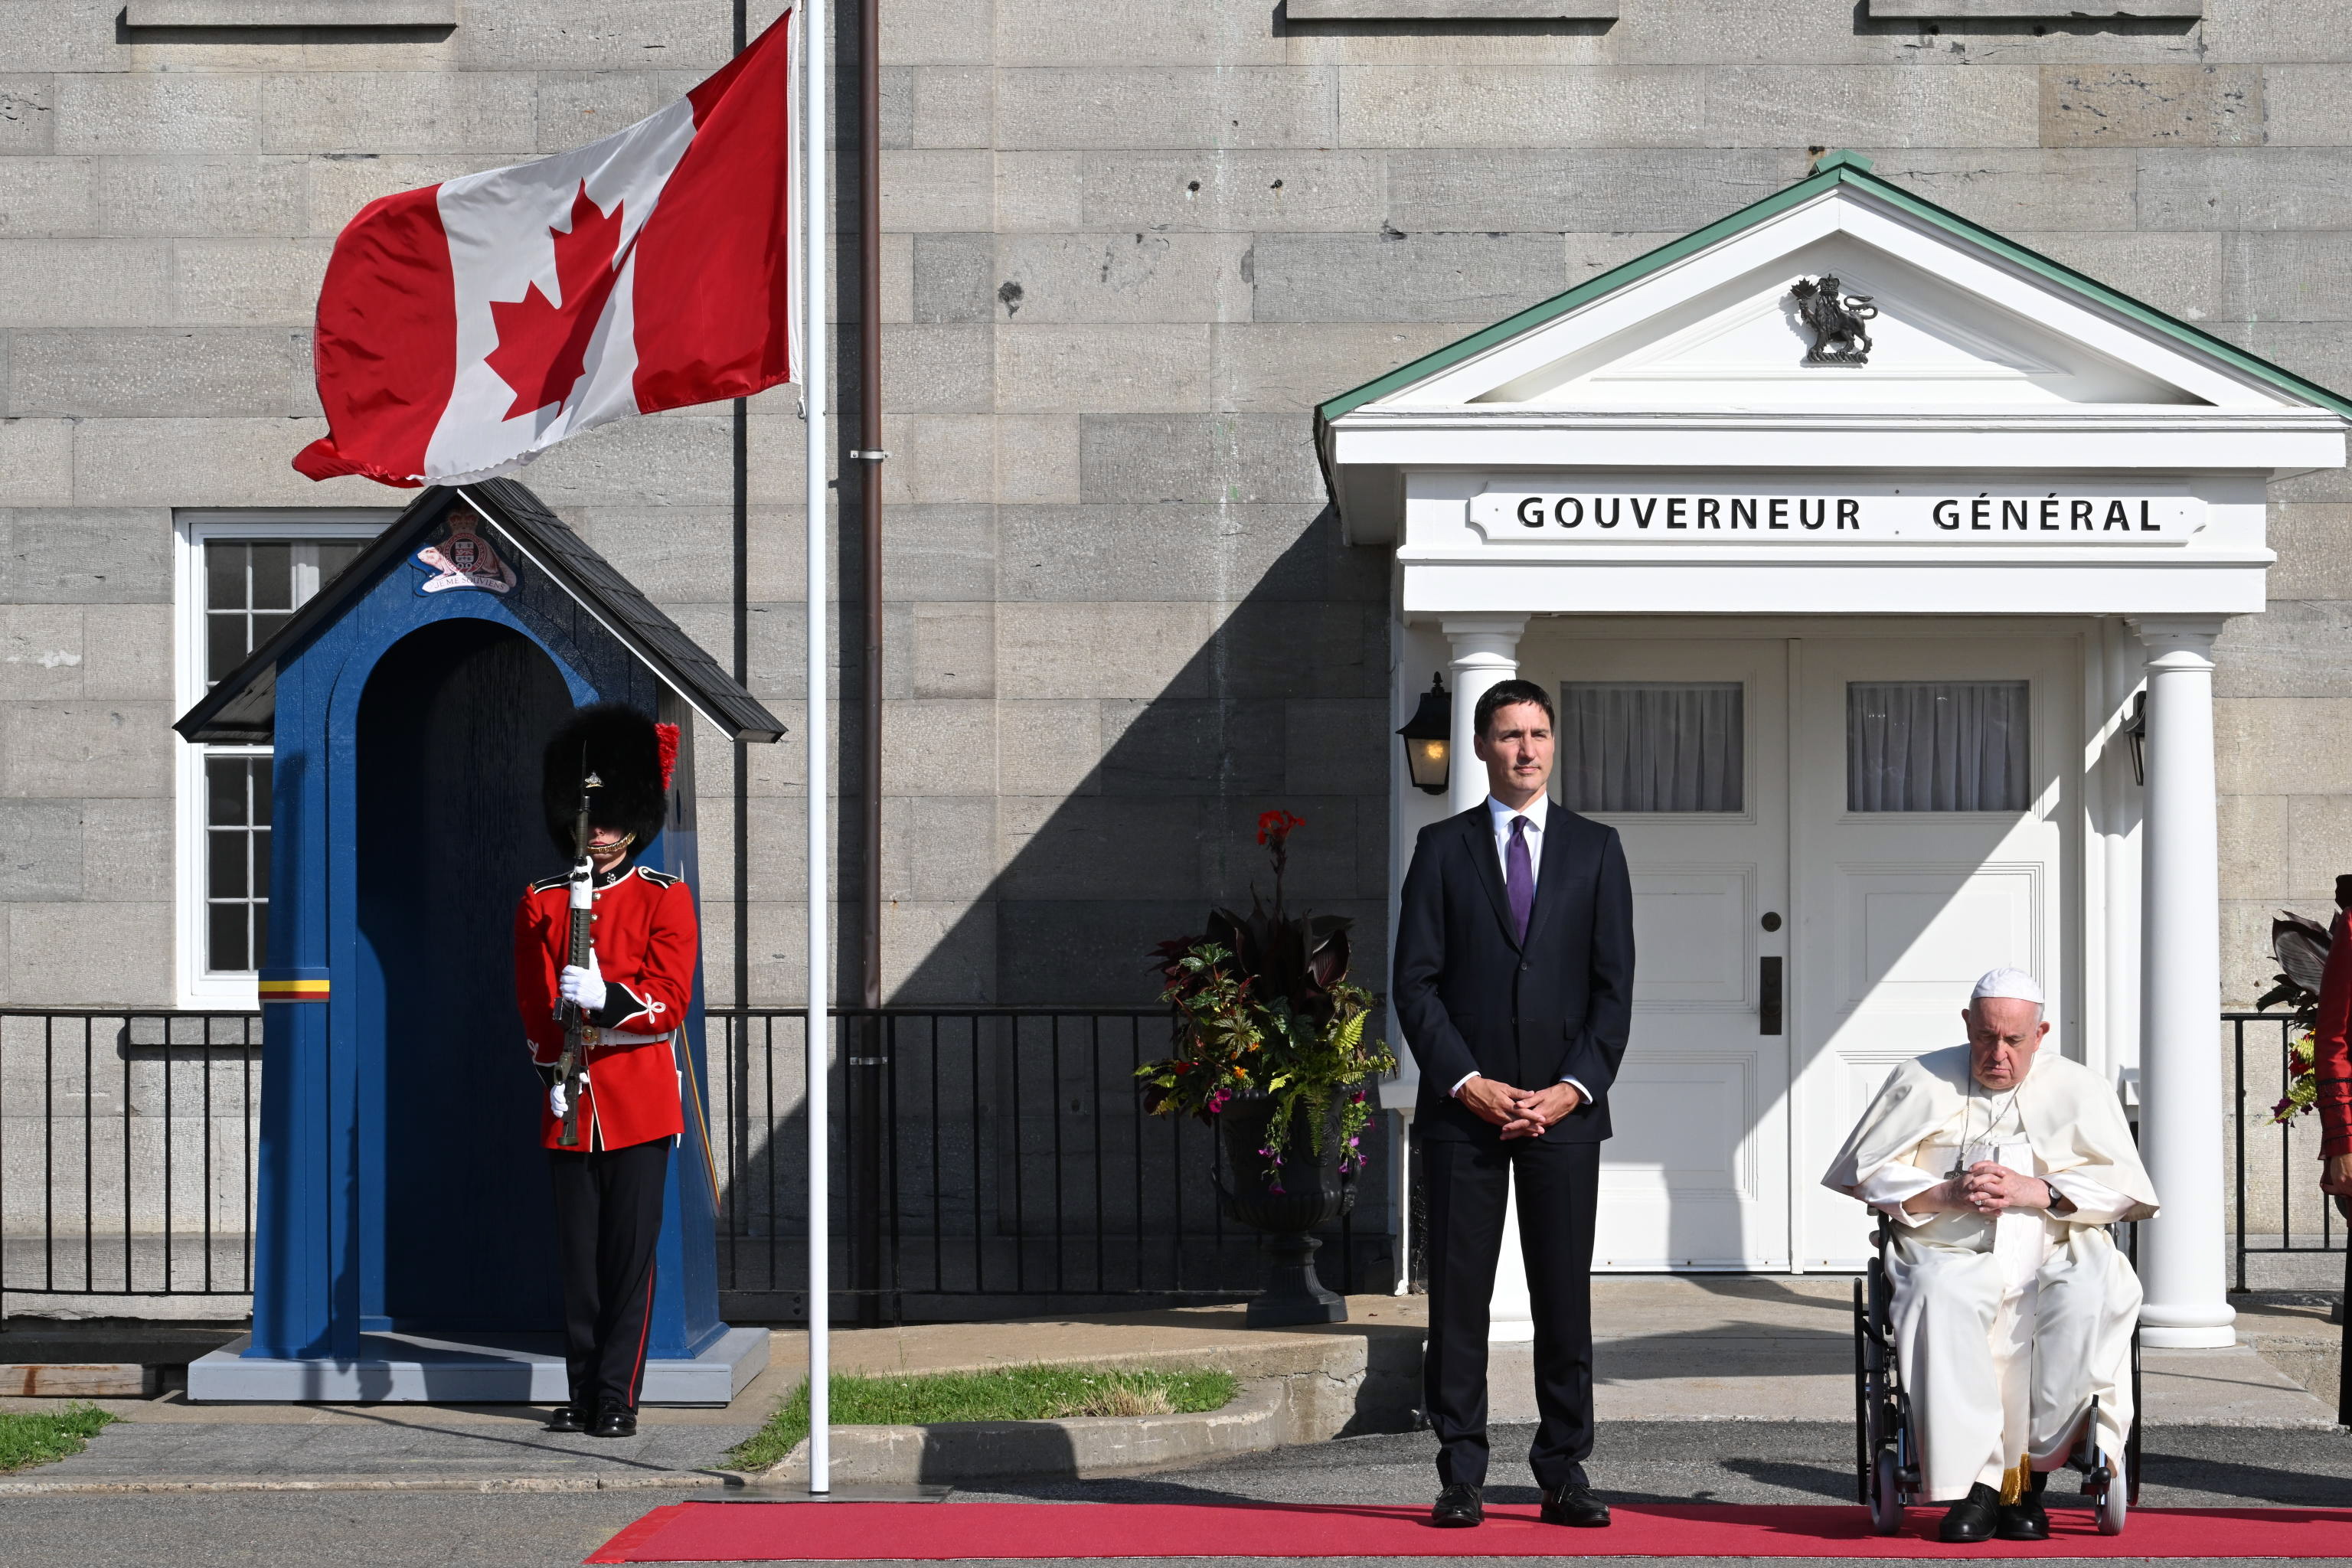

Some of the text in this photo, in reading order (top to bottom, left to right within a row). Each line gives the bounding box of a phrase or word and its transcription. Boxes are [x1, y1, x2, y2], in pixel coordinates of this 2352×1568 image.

[1516, 492, 2161, 531] GOUVERNEUR GÉNÉRAL
[446, 577, 460, 586] ME
[462, 577, 505, 590] SOUVIENS
